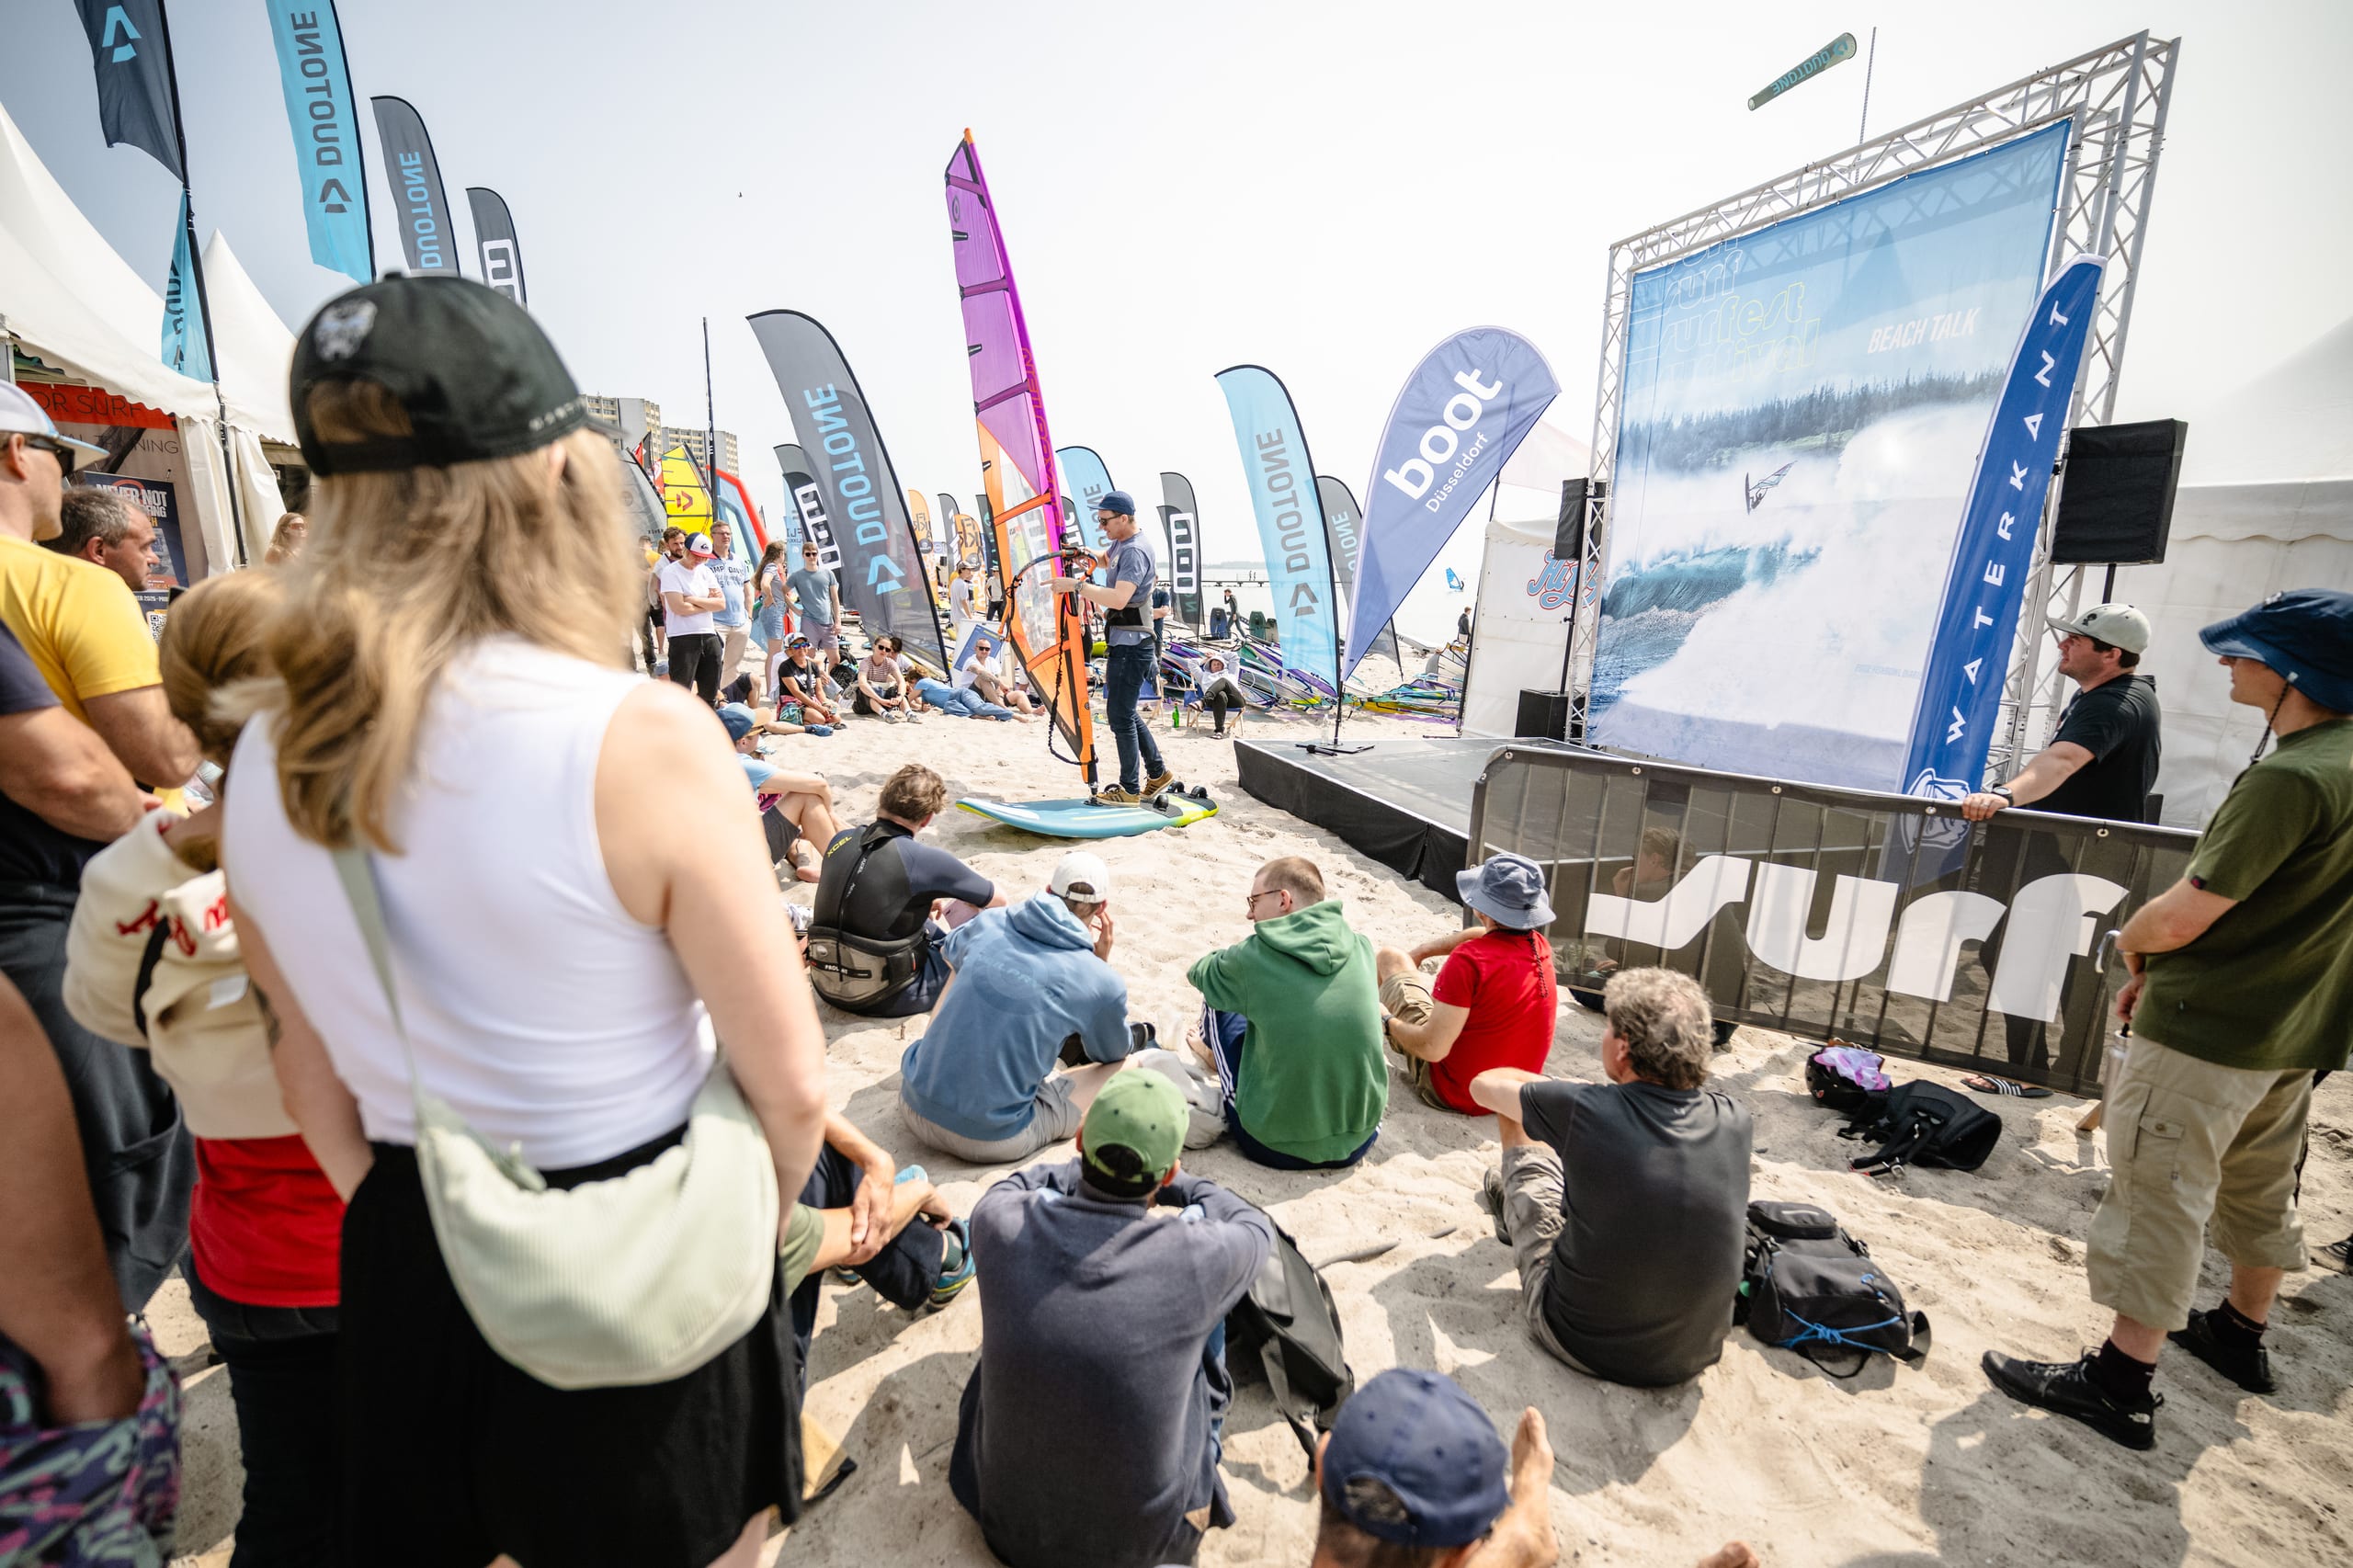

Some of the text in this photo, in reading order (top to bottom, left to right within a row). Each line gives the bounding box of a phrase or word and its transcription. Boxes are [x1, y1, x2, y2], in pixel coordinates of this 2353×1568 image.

[1770, 50, 1831, 95] DUOTONE
[1868, 307, 1983, 354] BEACH TALK
[1383, 368, 1503, 500] boot
[142, 488, 167, 506] NOT
[1425, 431, 1489, 513] Düsseldorf
[1946, 300, 2073, 745] WATERKANT
[826, 835, 853, 858] XCEL
[1584, 854, 2130, 1024] surf
